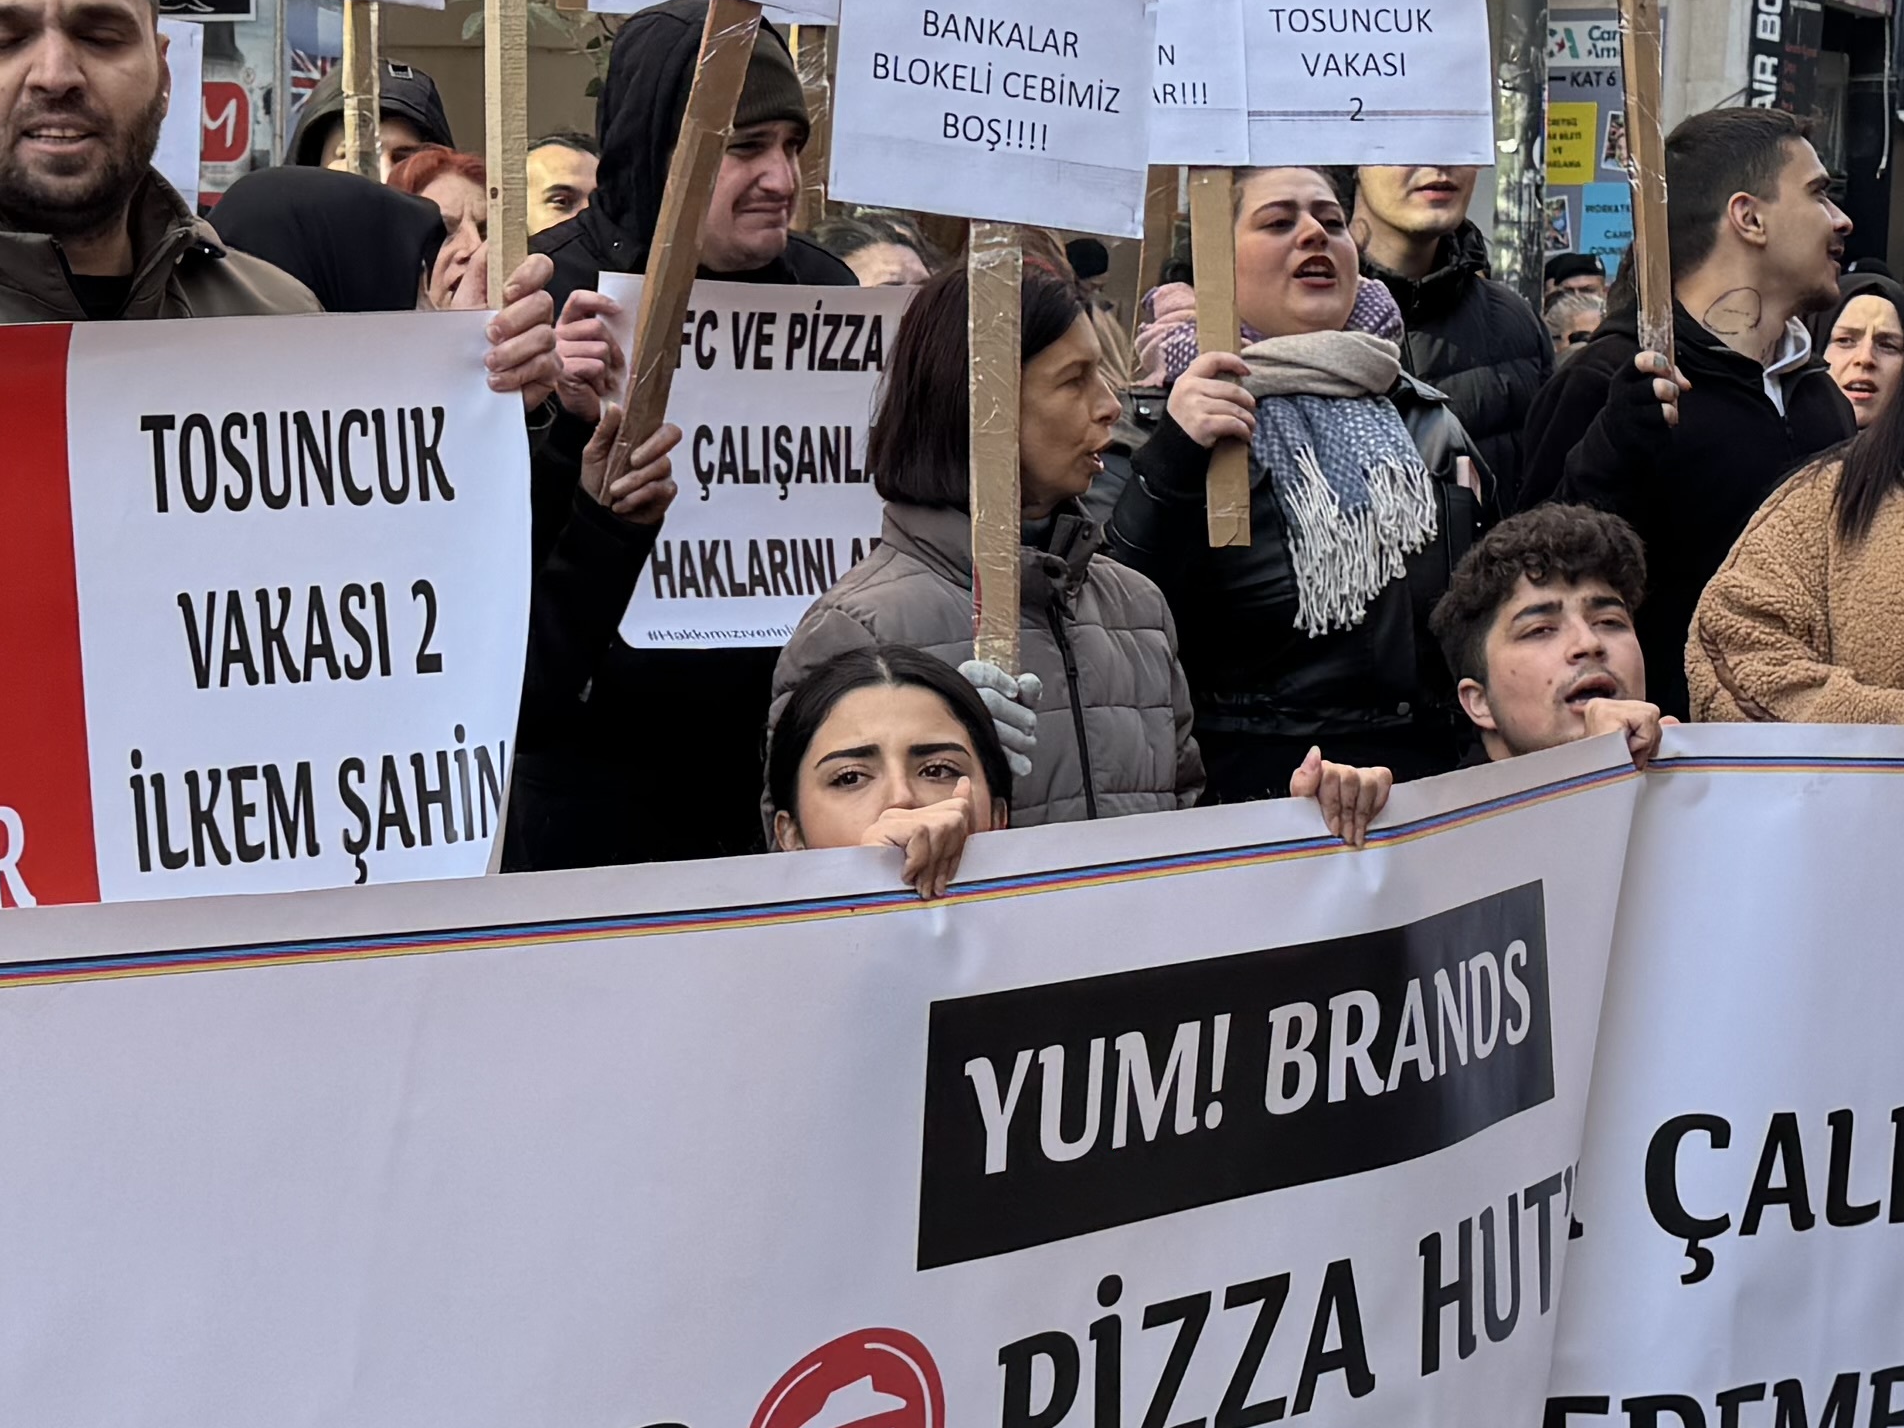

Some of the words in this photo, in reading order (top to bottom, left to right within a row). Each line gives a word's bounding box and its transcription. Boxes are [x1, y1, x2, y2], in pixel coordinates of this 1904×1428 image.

[921, 8, 1080, 59] BANKALAR
[1268, 7, 1434, 35] TOSUNCUK
[872, 52, 992, 96] BLOKELİ
[1002, 71, 1121, 115] CEBİMİZ
[1301, 51, 1408, 79] VAKASI
[1570, 71, 1602, 88] KAT
[1606, 70, 1617, 87] 6
[942, 112, 1049, 152] BOŞ!!!!
[1348, 97, 1366, 123] 2
[731, 311, 777, 371] VE
[785, 299, 884, 372] PİZZA
[139, 405, 456, 514] TOSUNCUK
[177, 581, 388, 689] VAKASI
[412, 581, 444, 676] 2
[129, 746, 316, 873] İLKEM
[336, 724, 507, 884] ŞAHİN
[962, 1012, 1230, 1183] YUM!
[1263, 938, 1535, 1119] BRANDS
